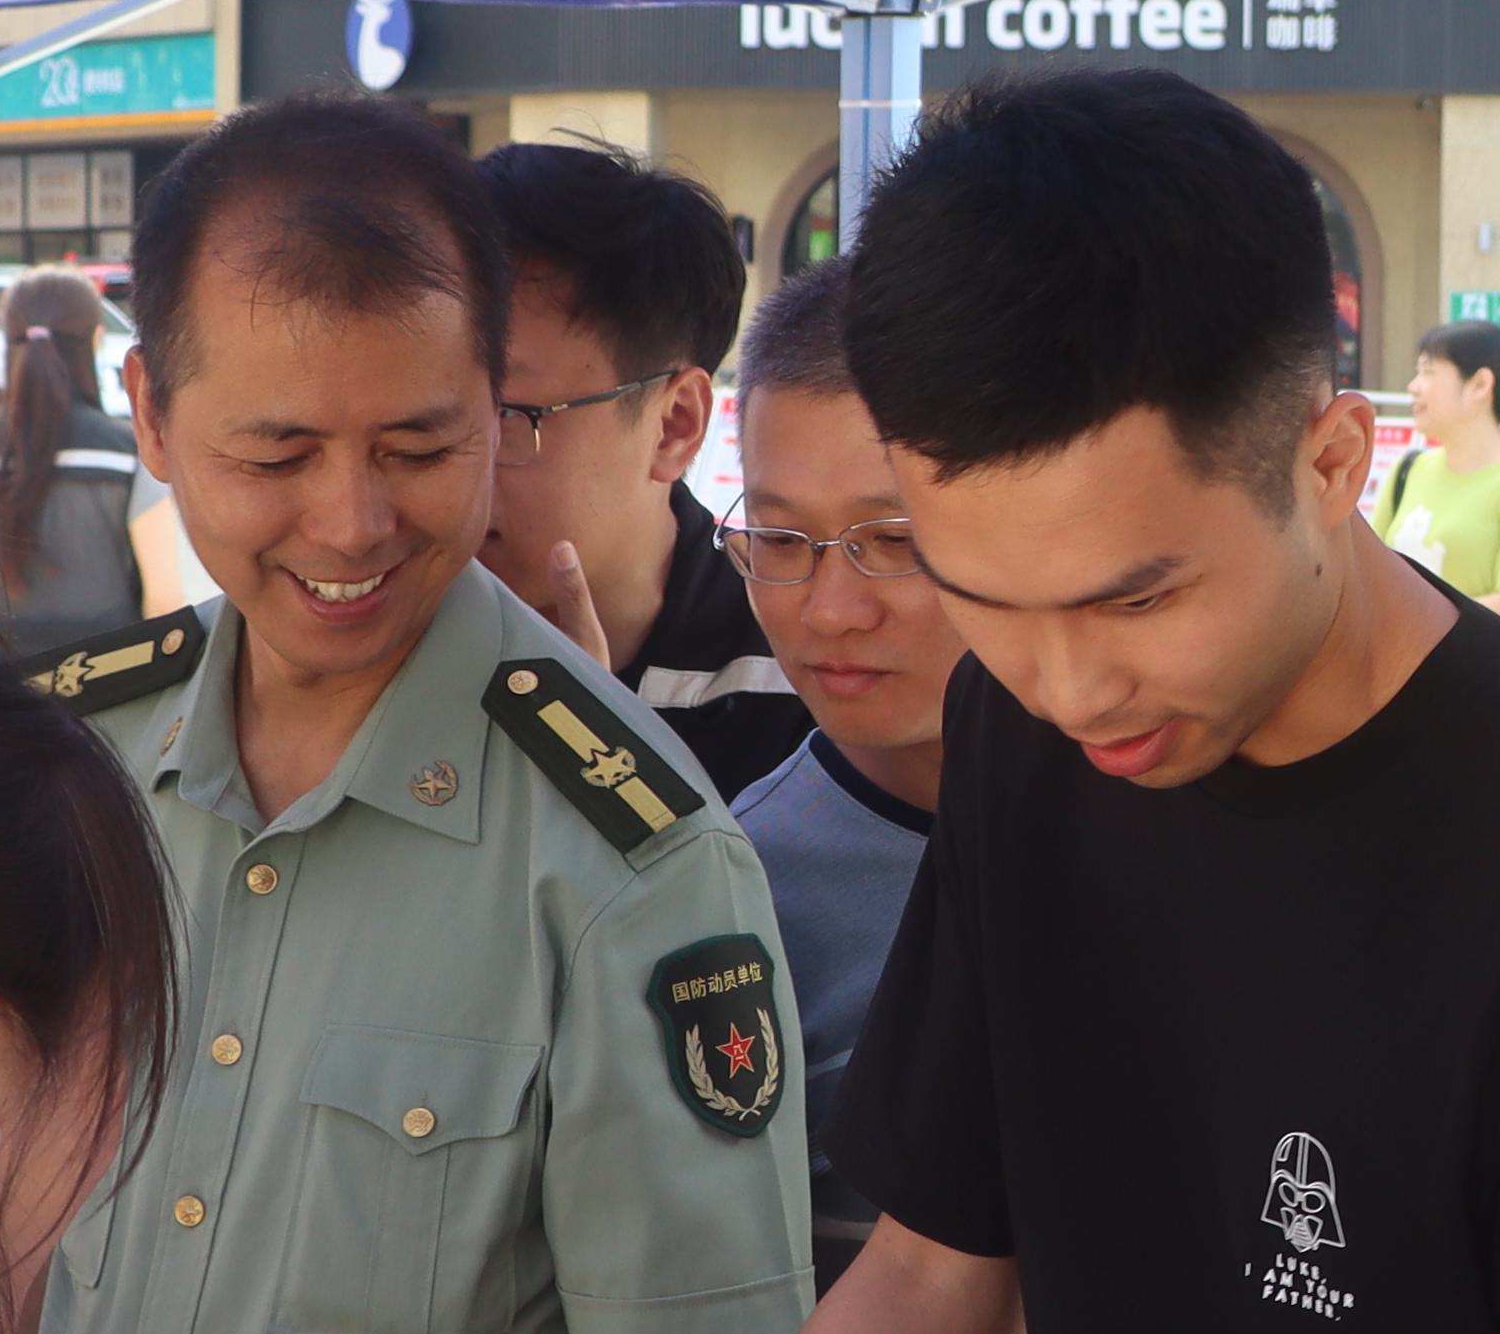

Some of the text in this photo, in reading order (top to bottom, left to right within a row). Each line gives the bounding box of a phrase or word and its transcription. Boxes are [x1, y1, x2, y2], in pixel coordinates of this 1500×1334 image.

[671, 961, 764, 1005] 国防动员单位
[1244, 1262, 1355, 1309] I AM YOUR
